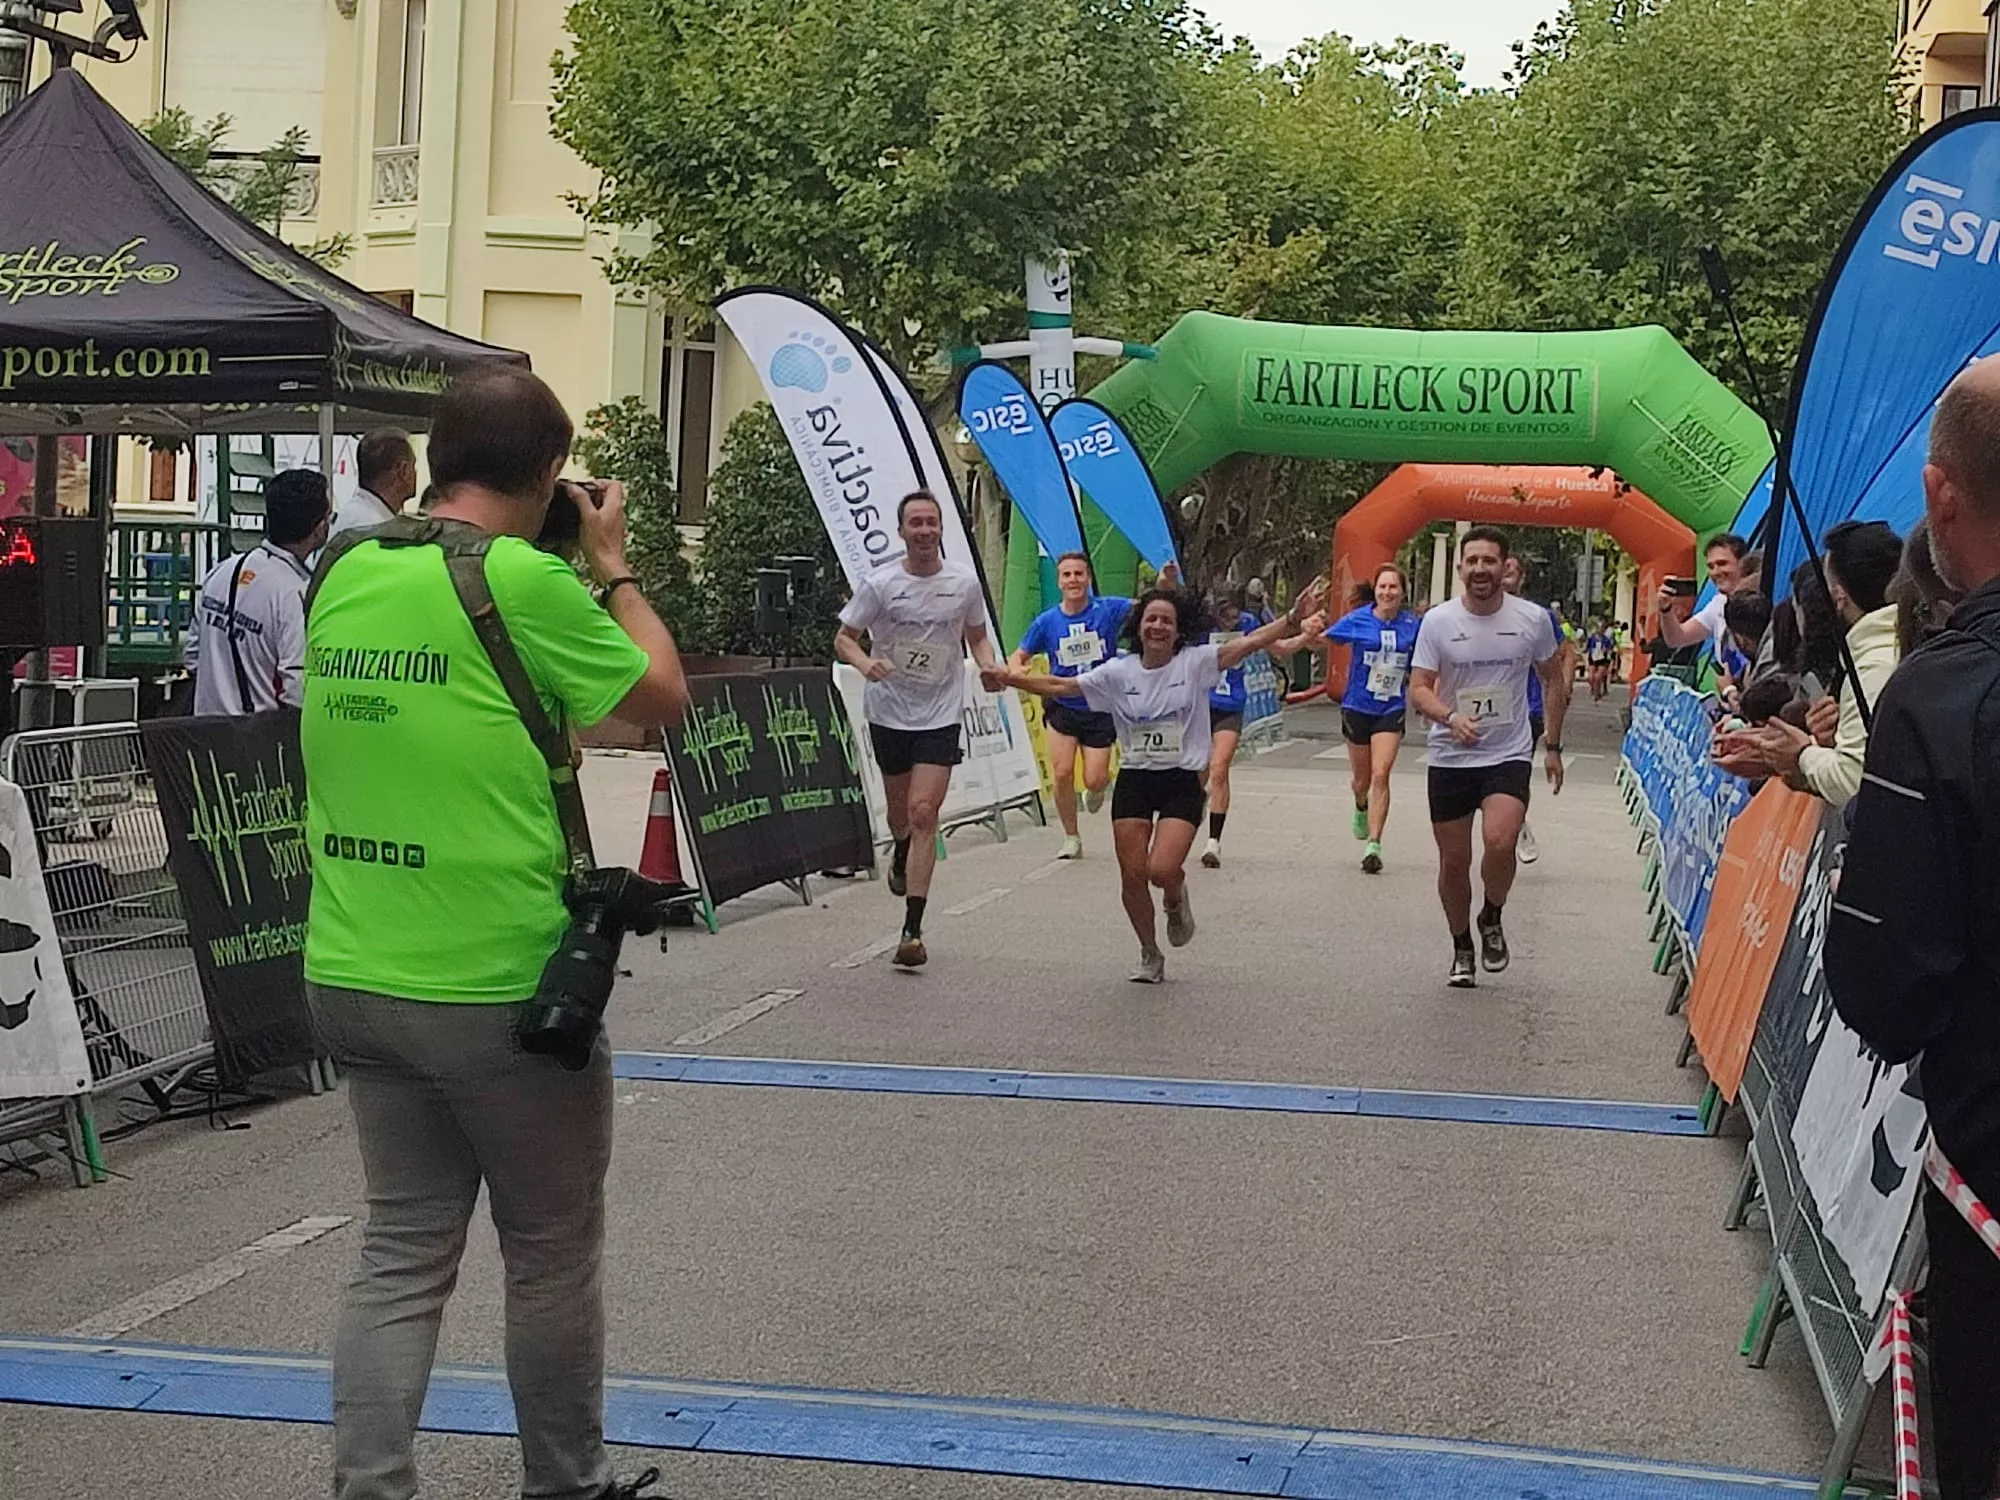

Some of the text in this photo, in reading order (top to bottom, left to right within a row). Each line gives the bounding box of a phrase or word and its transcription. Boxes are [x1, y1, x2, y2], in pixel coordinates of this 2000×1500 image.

[1890, 185, 2000, 266] esi
[1253, 357, 1582, 415] FARTLECK SPORT
[1471, 422, 1492, 433] DE
[1496, 422, 1571, 434] EVENTOS
[1555, 477, 1610, 492] Huesca
[907, 651, 931, 668] 72
[1471, 699, 1494, 715] 71
[1143, 733, 1164, 747] 70
